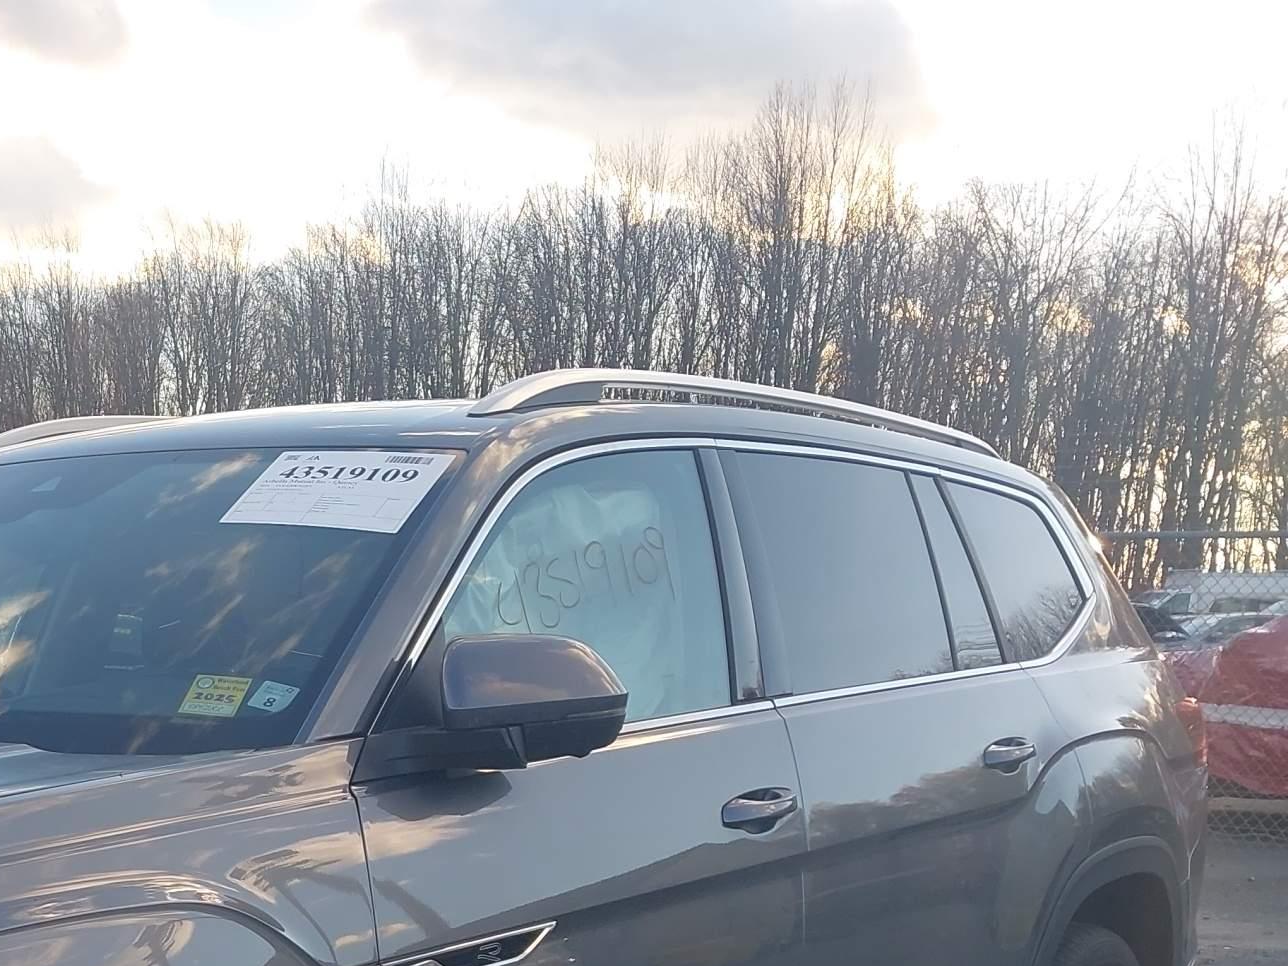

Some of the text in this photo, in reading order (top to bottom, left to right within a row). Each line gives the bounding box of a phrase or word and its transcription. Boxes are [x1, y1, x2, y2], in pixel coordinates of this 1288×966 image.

[278, 465, 420, 483] 43519109
[191, 692, 238, 704] 2025
[263, 697, 277, 708] 8
